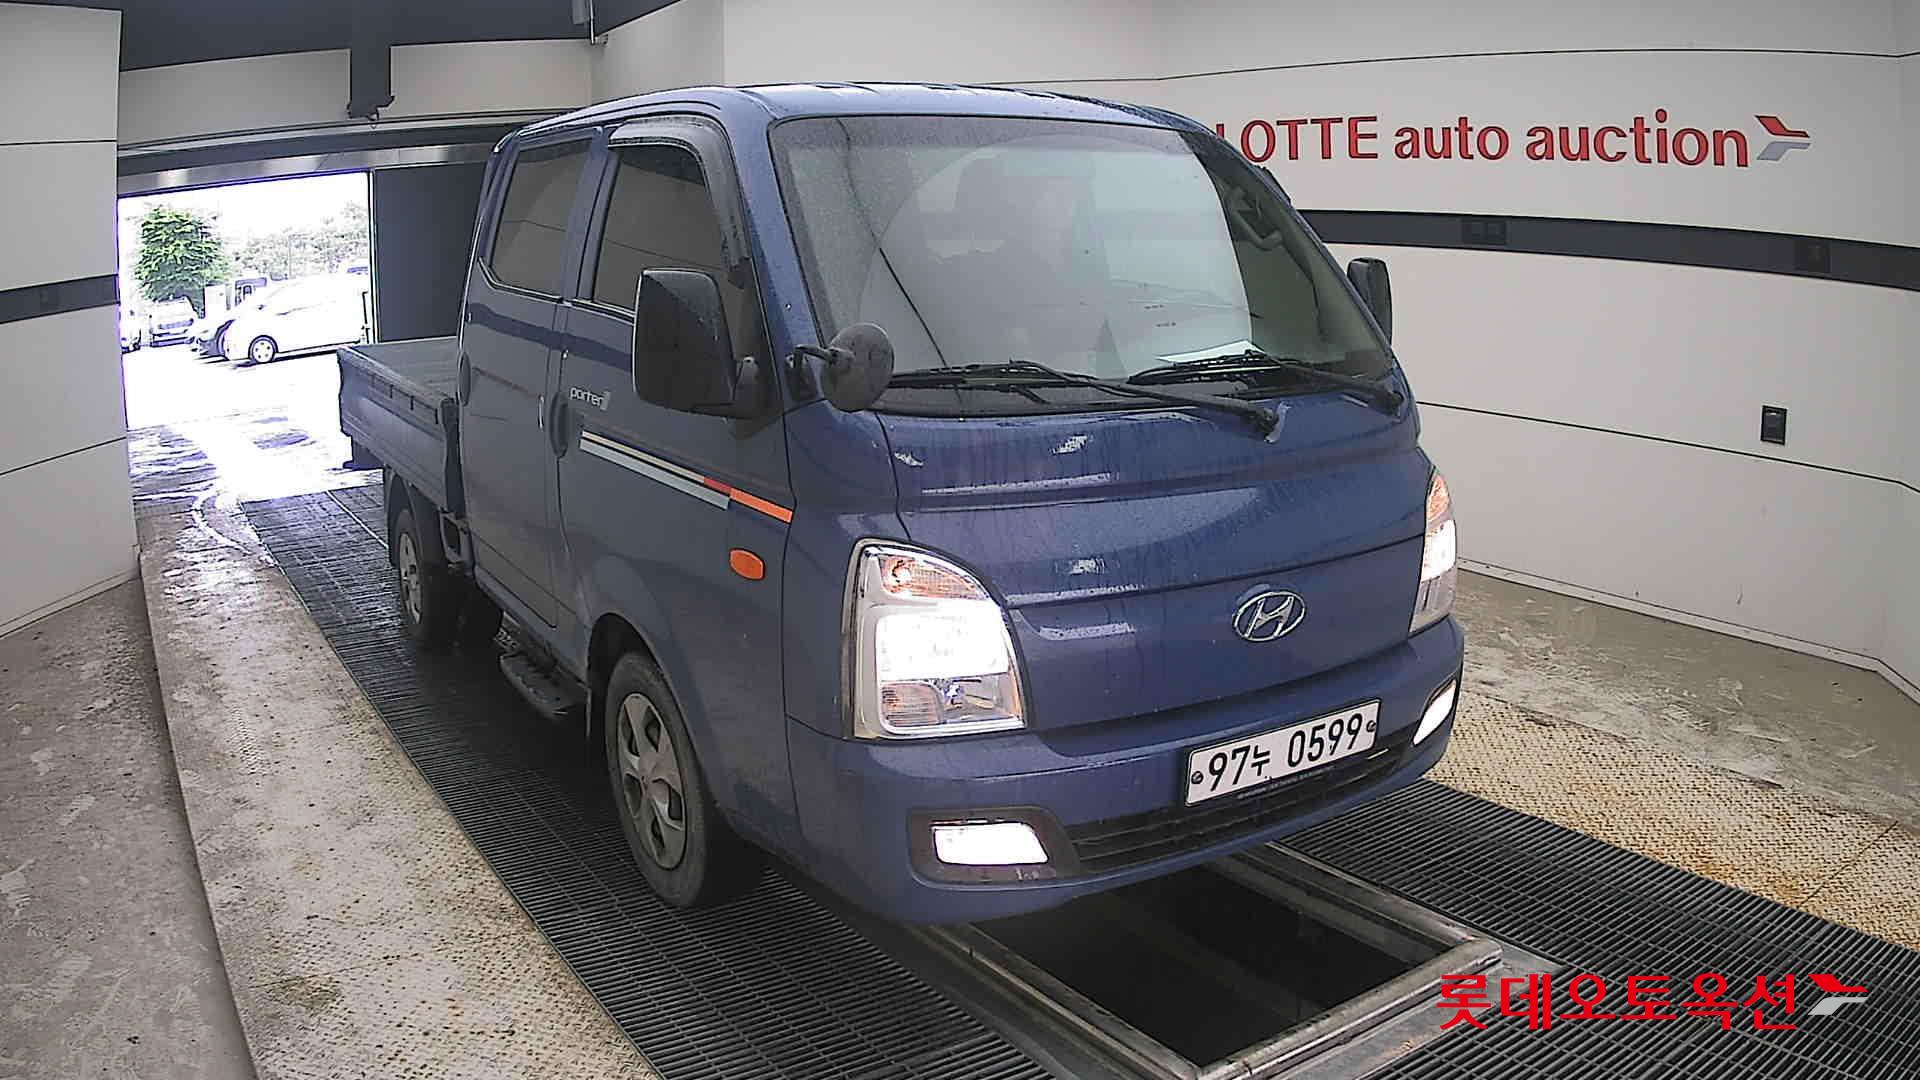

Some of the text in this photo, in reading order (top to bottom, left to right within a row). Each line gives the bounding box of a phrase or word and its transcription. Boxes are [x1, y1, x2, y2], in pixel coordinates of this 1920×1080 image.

[1394, 115, 1509, 161] auto
[1525, 108, 1749, 167] auction
[569, 386, 604, 407] porter
[1208, 744, 1270, 791] 97누
[1287, 713, 1363, 767] 0599
